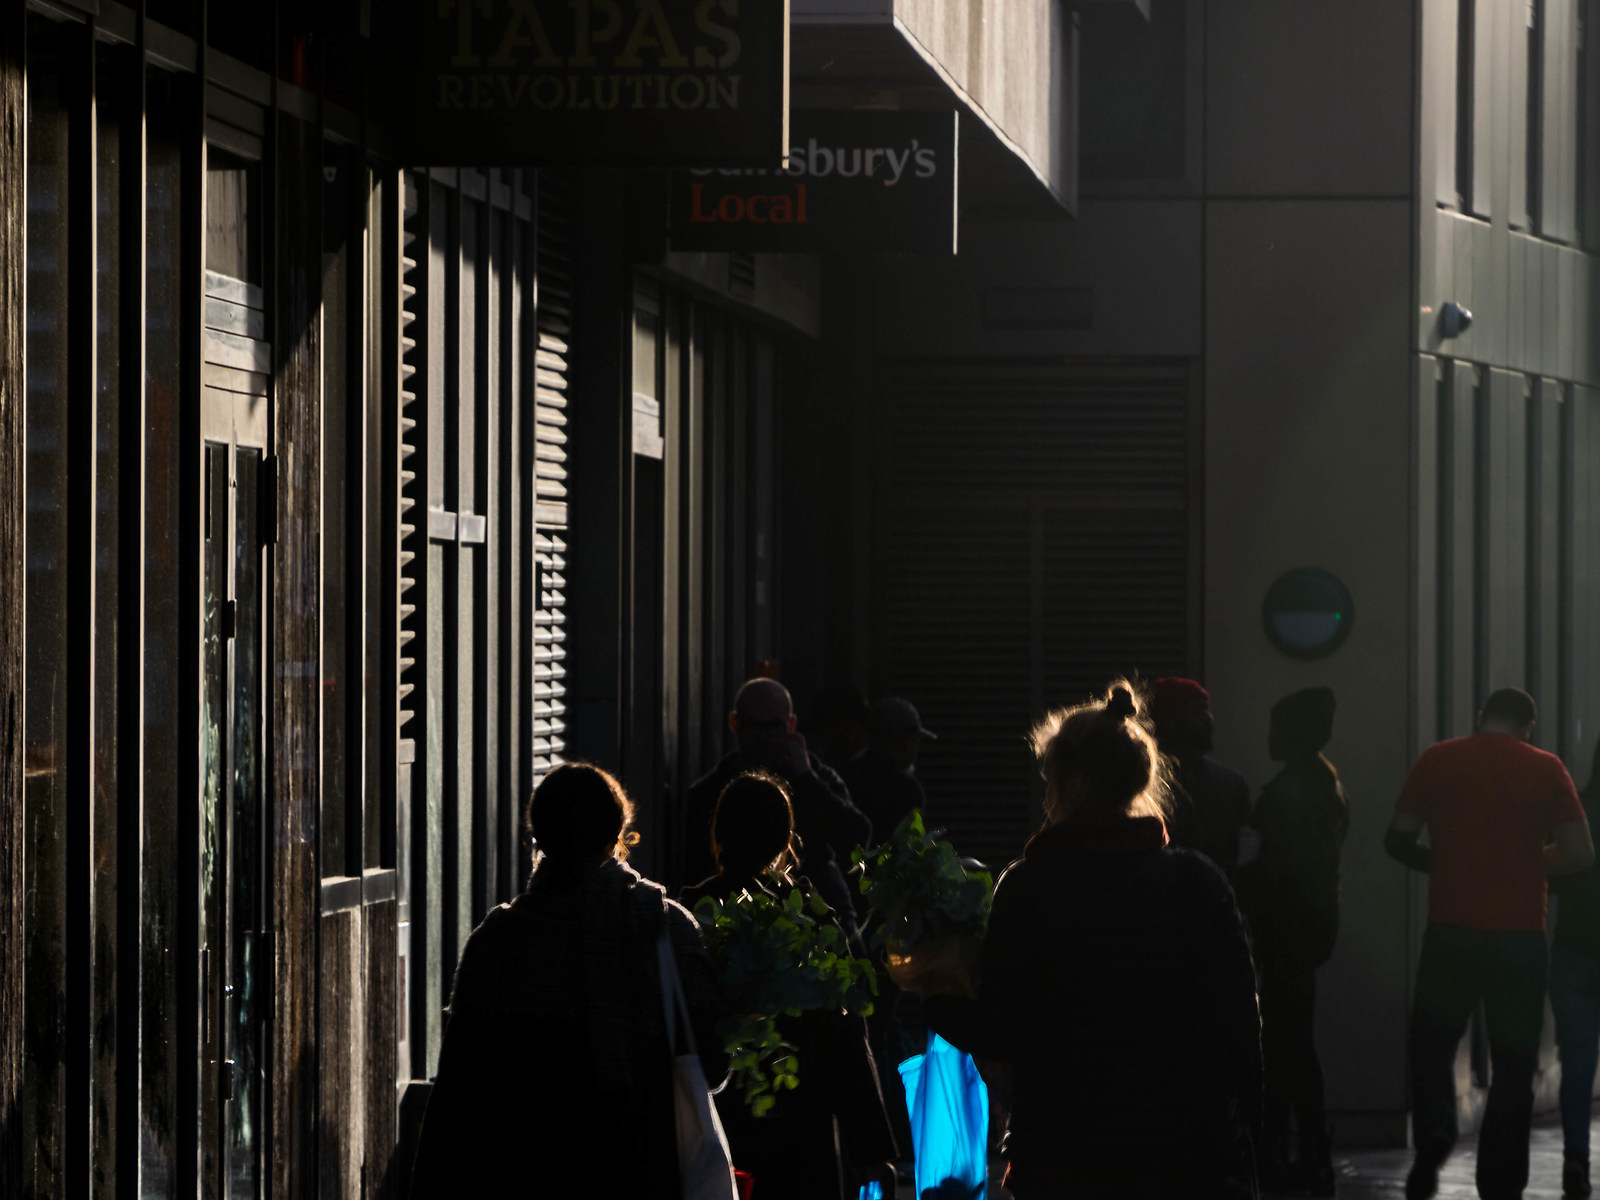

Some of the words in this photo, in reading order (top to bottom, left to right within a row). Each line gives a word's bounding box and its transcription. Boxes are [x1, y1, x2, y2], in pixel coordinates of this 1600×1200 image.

[437, 0, 742, 69] TAPAS
[436, 74, 742, 111] REVOLUTION
[689, 138, 936, 187] sbury's
[690, 183, 809, 225] Local
